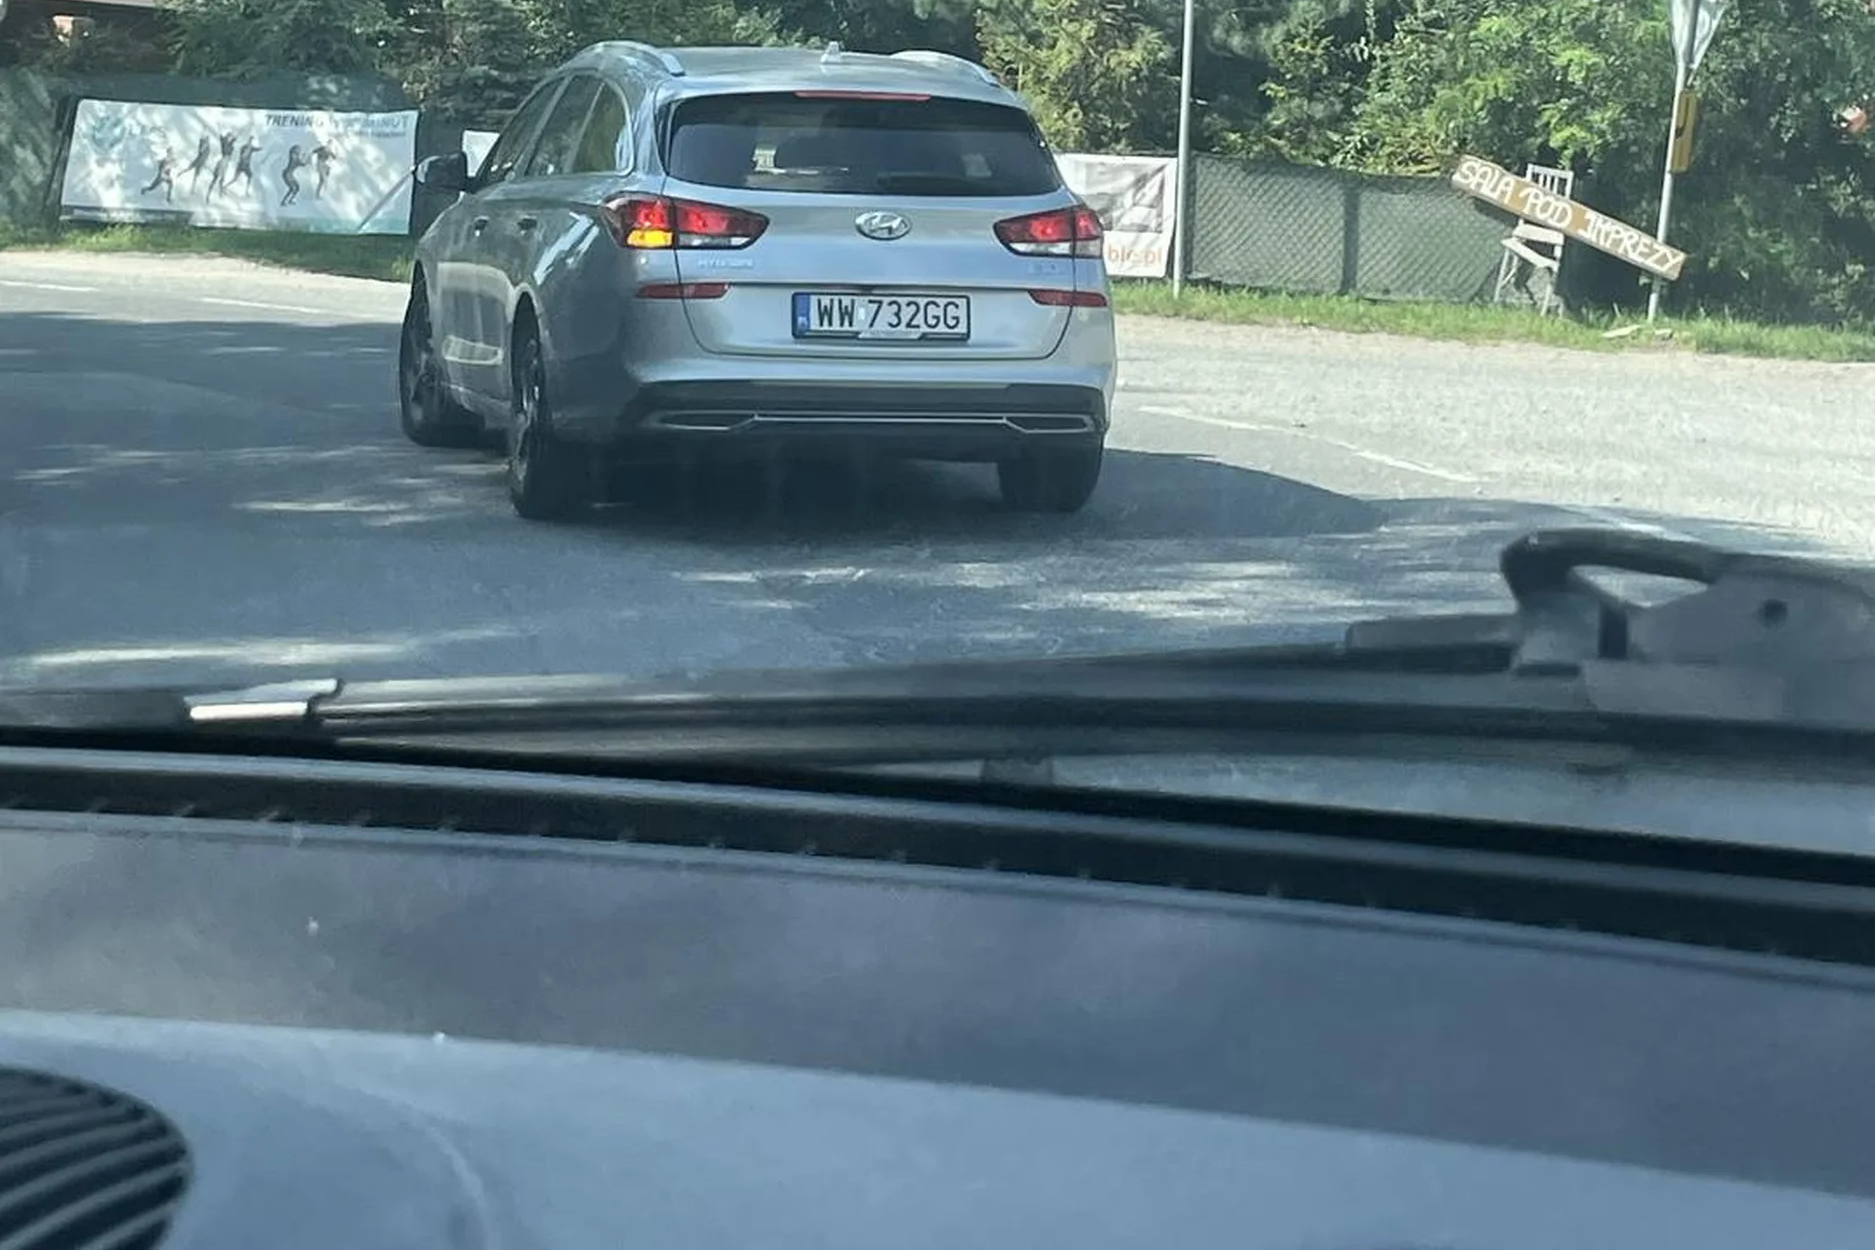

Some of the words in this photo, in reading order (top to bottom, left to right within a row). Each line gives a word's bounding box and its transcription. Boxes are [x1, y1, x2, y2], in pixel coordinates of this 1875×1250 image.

[1456, 160, 1515, 205] SALA
[1517, 186, 1573, 228] POD
[1577, 210, 1687, 273] IMPREZY
[816, 297, 856, 328] WW
[867, 299, 960, 330] 732GG
